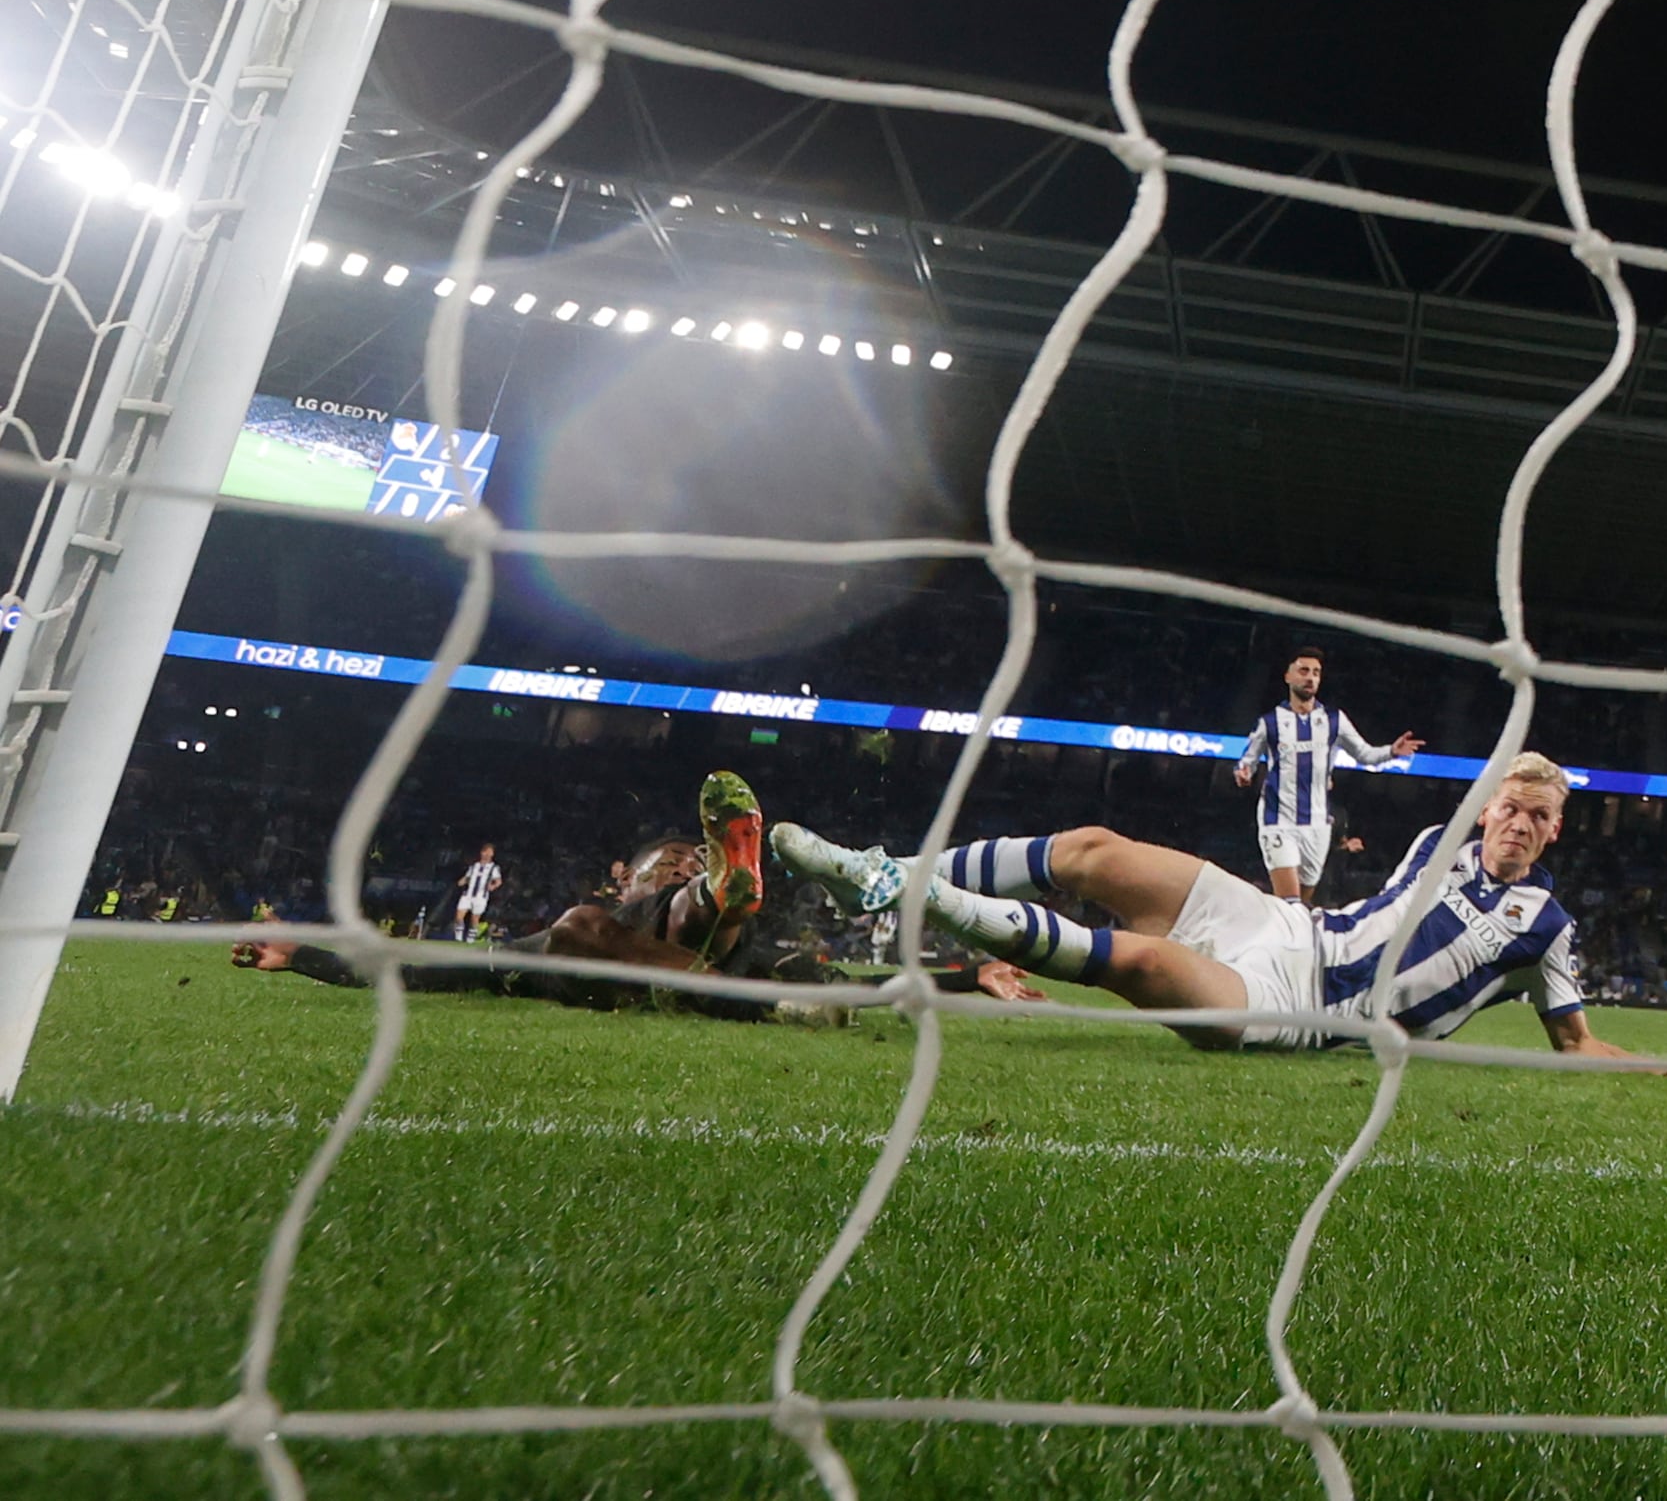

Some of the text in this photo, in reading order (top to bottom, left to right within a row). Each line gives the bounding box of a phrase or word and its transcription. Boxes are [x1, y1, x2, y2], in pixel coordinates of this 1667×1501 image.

[295, 396, 389, 423] LG OLED TV
[235, 639, 384, 677] hazi & hezi
[1443, 885, 1502, 957] YASUDA
